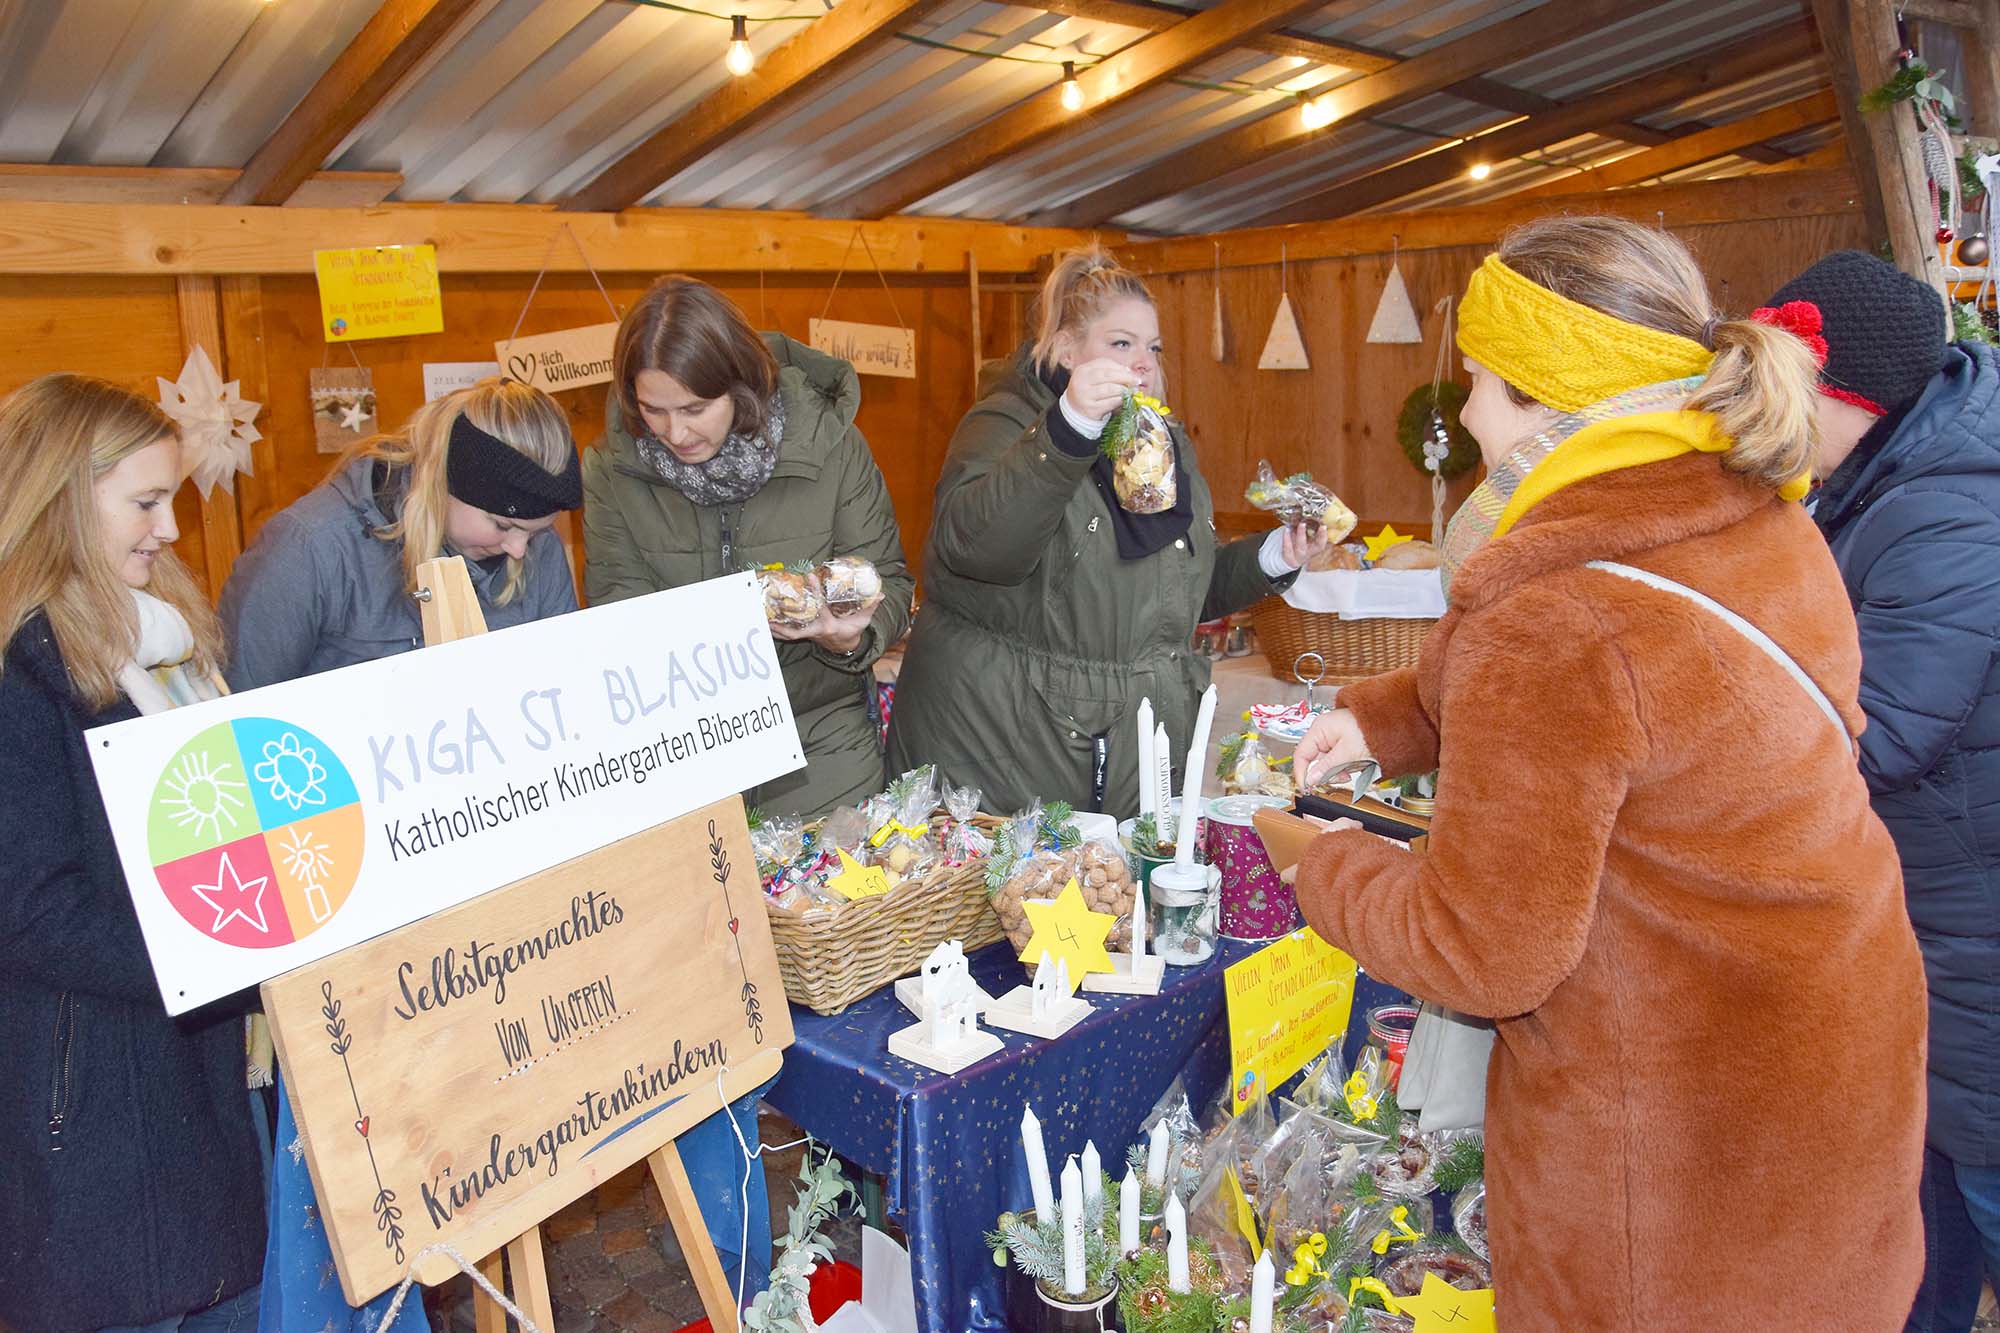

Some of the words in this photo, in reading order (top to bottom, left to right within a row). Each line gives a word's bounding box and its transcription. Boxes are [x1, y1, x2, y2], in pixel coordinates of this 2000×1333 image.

[368, 707, 505, 804] KIGA
[520, 687, 580, 751] ST.
[603, 627, 770, 726] BLASIUS
[385, 777, 549, 862] Katholischer
[553, 729, 698, 802] Kindergarten
[698, 695, 785, 751] Biberach
[394, 890, 624, 1021] Selbstgemachtes
[1054, 922, 1081, 951] 4
[494, 1016, 531, 1068] VON
[541, 975, 617, 1043] UNSEREN
[421, 1039, 727, 1230] Kindergartenkindern
